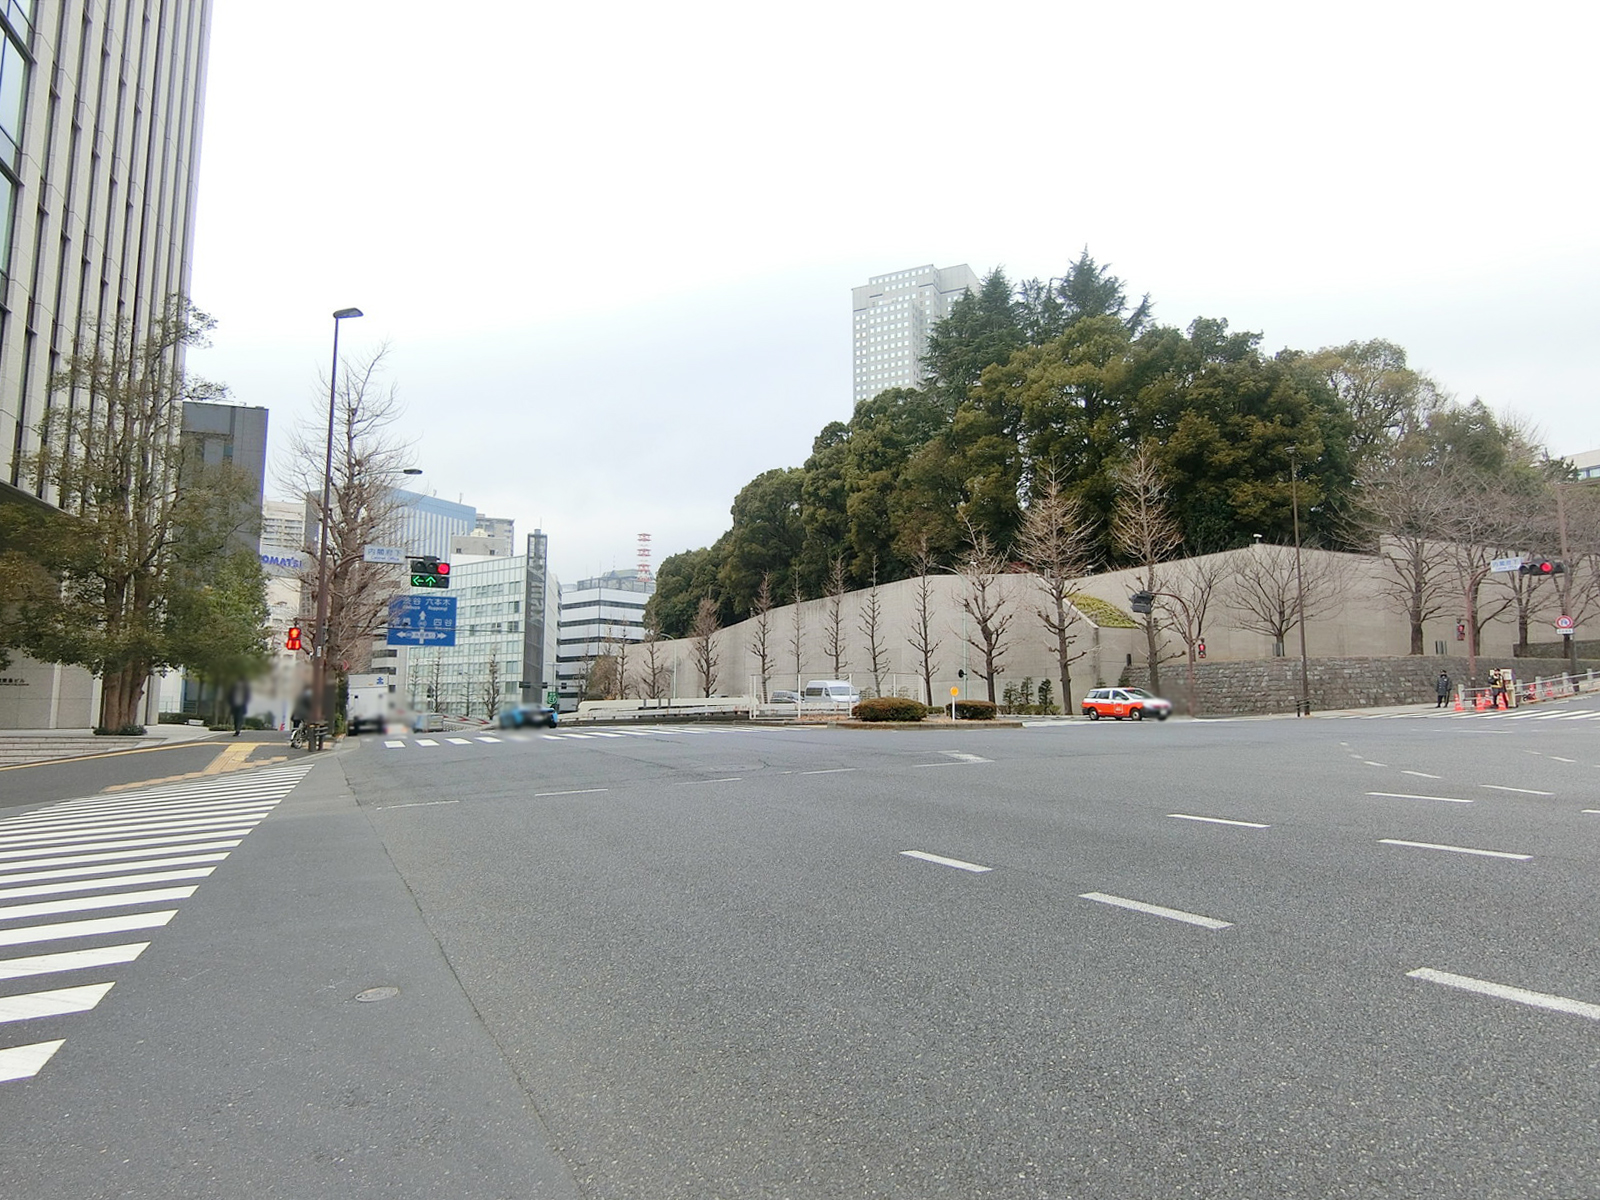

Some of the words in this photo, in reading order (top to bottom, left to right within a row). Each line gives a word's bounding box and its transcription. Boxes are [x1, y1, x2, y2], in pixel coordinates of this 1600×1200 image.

[261, 555, 303, 567] OMATSU
[425, 598, 451, 606] 六本木
